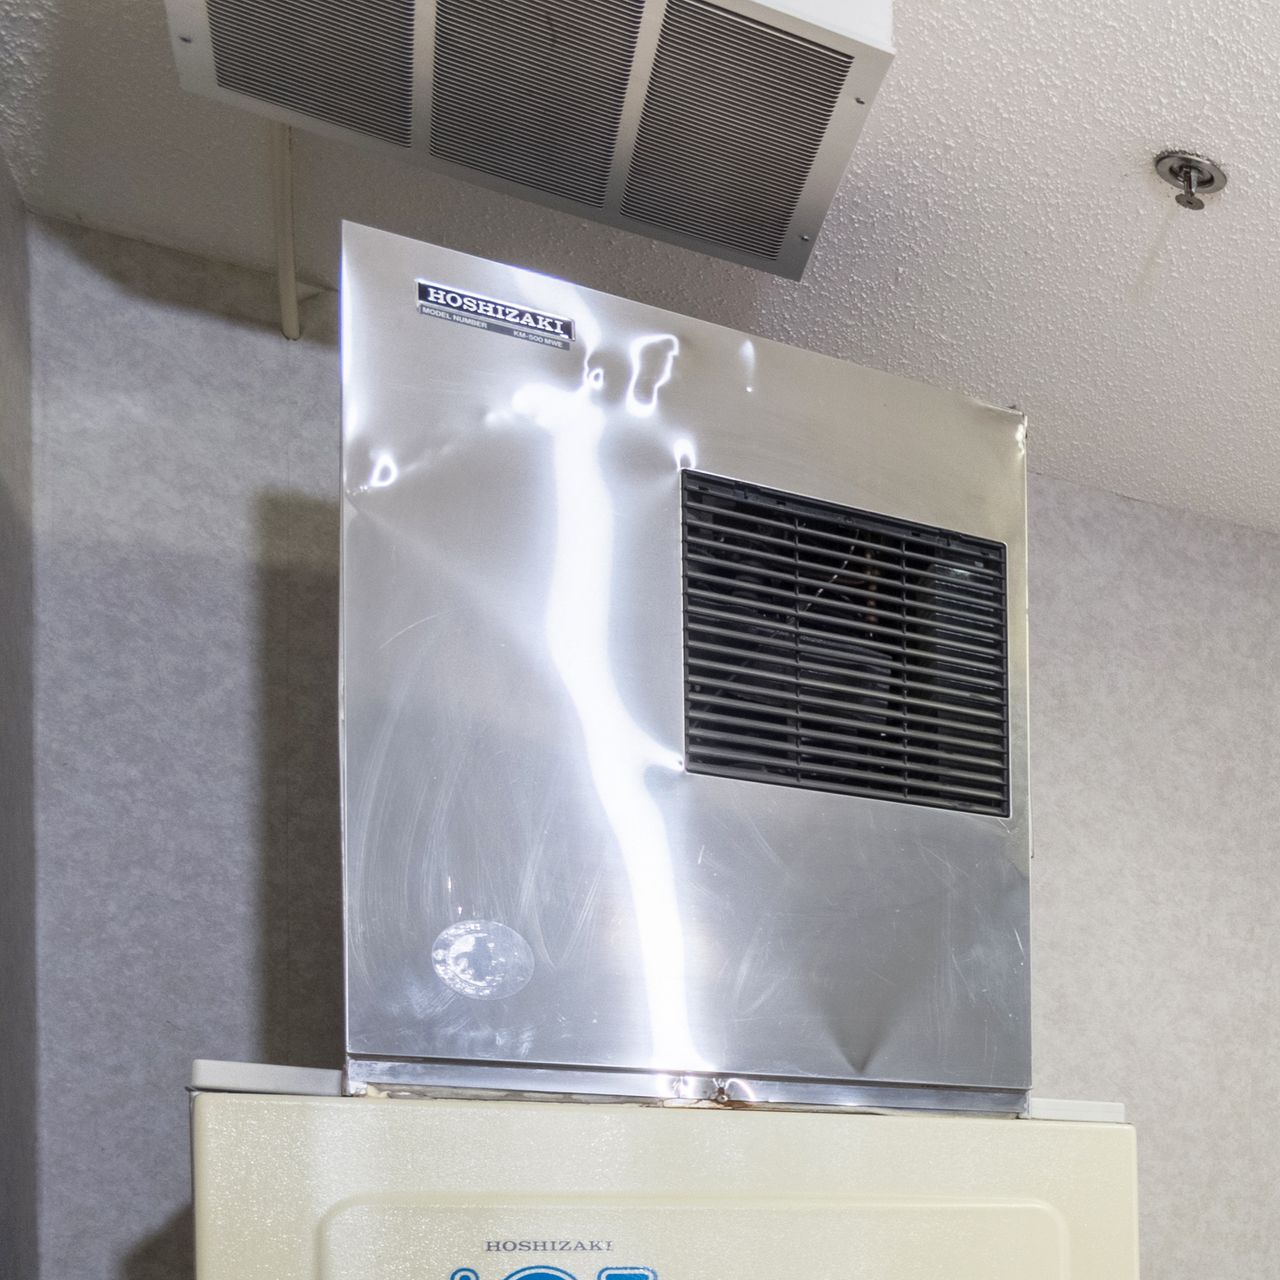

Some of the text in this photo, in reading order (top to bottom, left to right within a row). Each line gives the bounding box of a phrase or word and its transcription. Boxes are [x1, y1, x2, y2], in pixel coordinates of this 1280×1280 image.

[422, 306, 452, 320] MODEL
[452, 314, 488, 329] NUMBER
[427, 287, 565, 334] HOSHIZAKI
[485, 1240, 614, 1252] HOSHIZAKI
